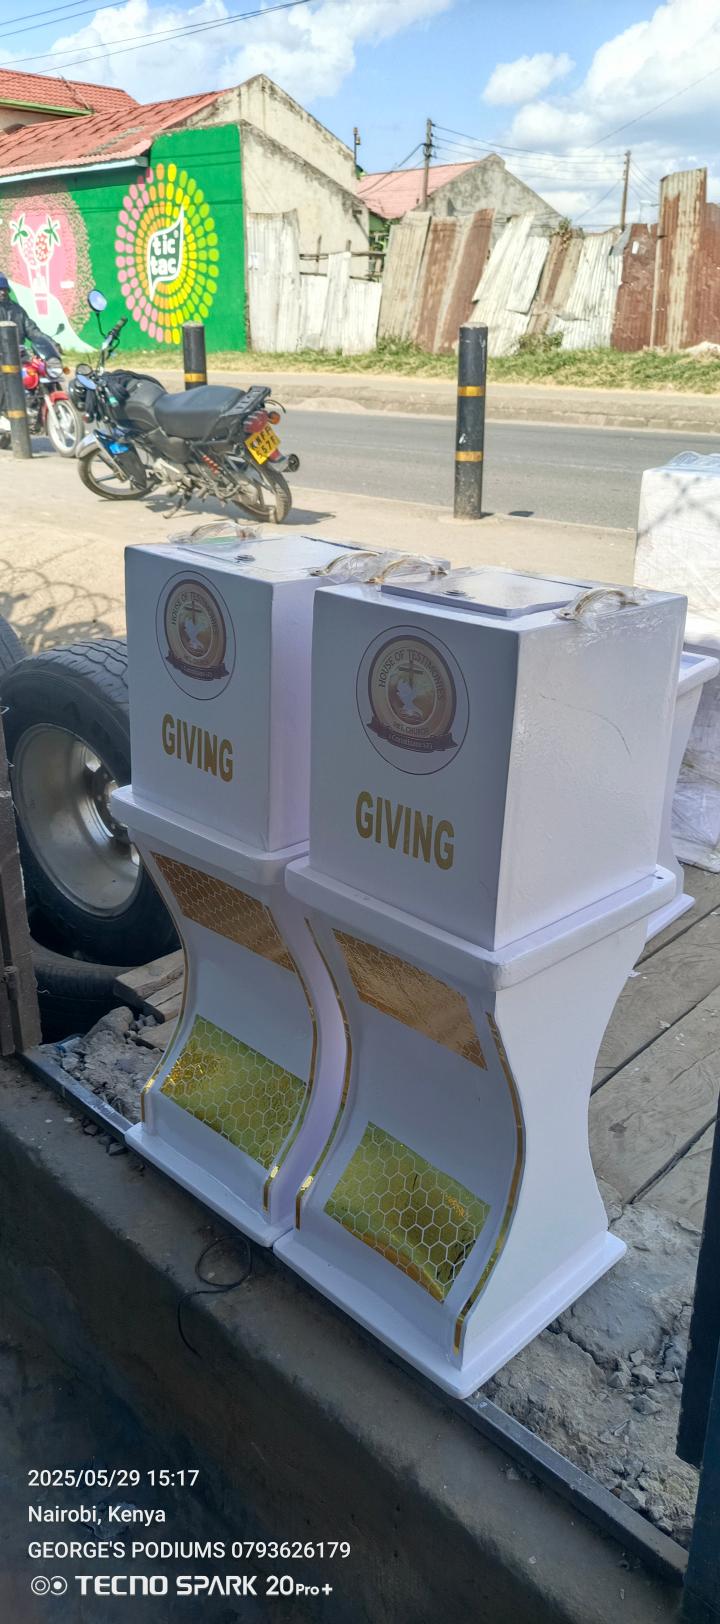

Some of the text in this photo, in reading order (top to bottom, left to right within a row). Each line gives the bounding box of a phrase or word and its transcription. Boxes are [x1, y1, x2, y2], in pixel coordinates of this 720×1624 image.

[150, 255, 177, 276] tac
[152, 233, 176, 256] tic
[378, 648, 444, 700] HOUSE OF TESTIMONIES
[161, 713, 234, 783] GIVING
[355, 790, 456, 871] GIVING
